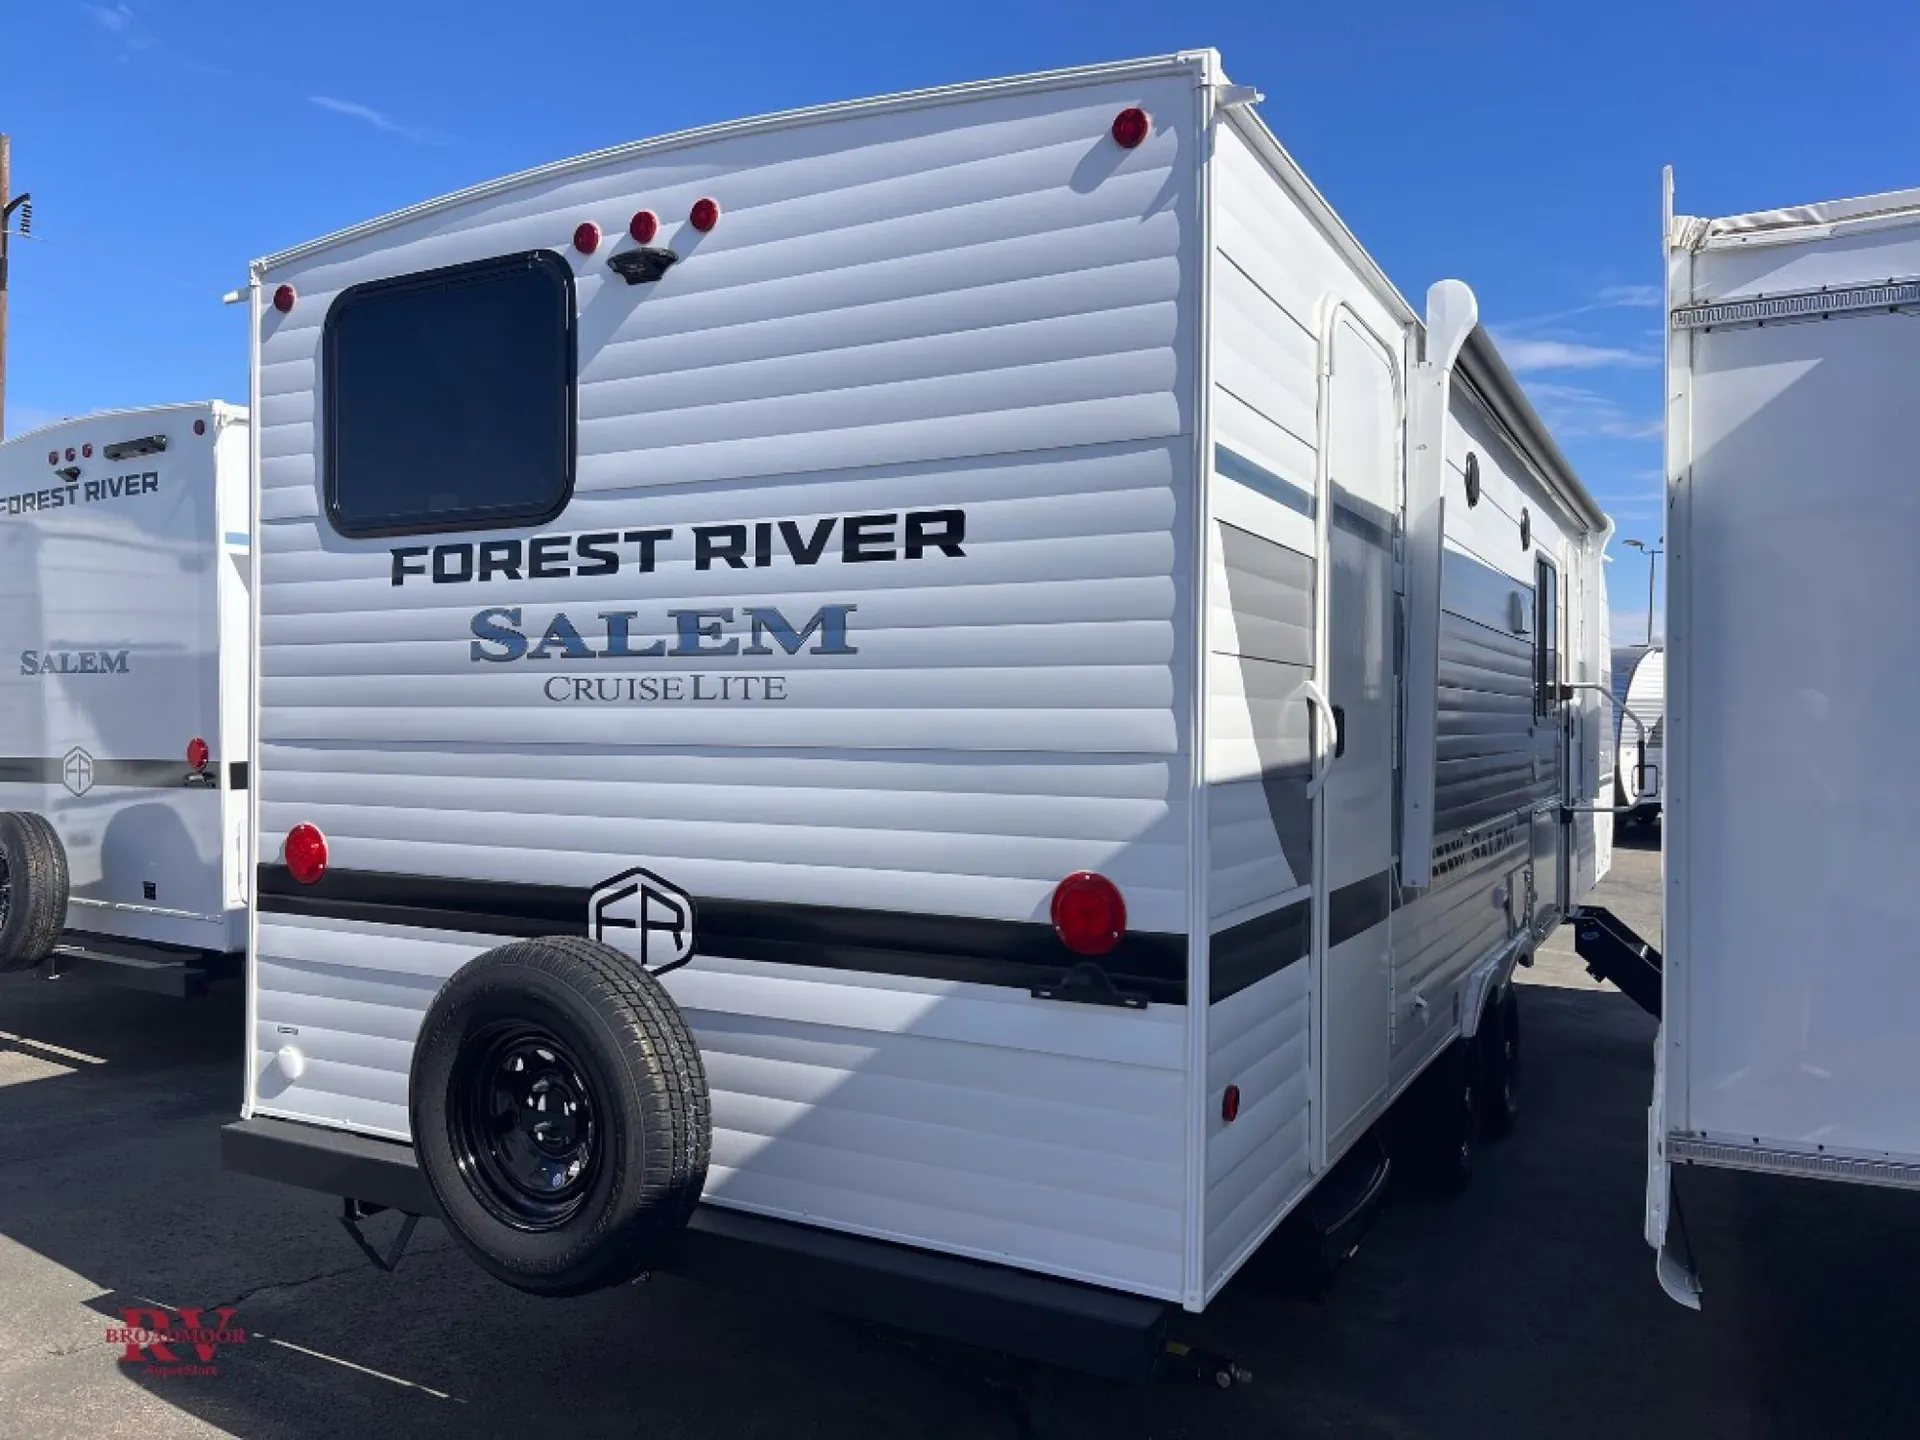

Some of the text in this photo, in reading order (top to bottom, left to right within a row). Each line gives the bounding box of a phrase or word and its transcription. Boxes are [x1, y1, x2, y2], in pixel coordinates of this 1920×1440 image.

[84, 470, 158, 502] RIVER
[390, 509, 966, 586] FOREST RIVER
[469, 604, 858, 662] SALEM
[20, 650, 130, 675] SALEM
